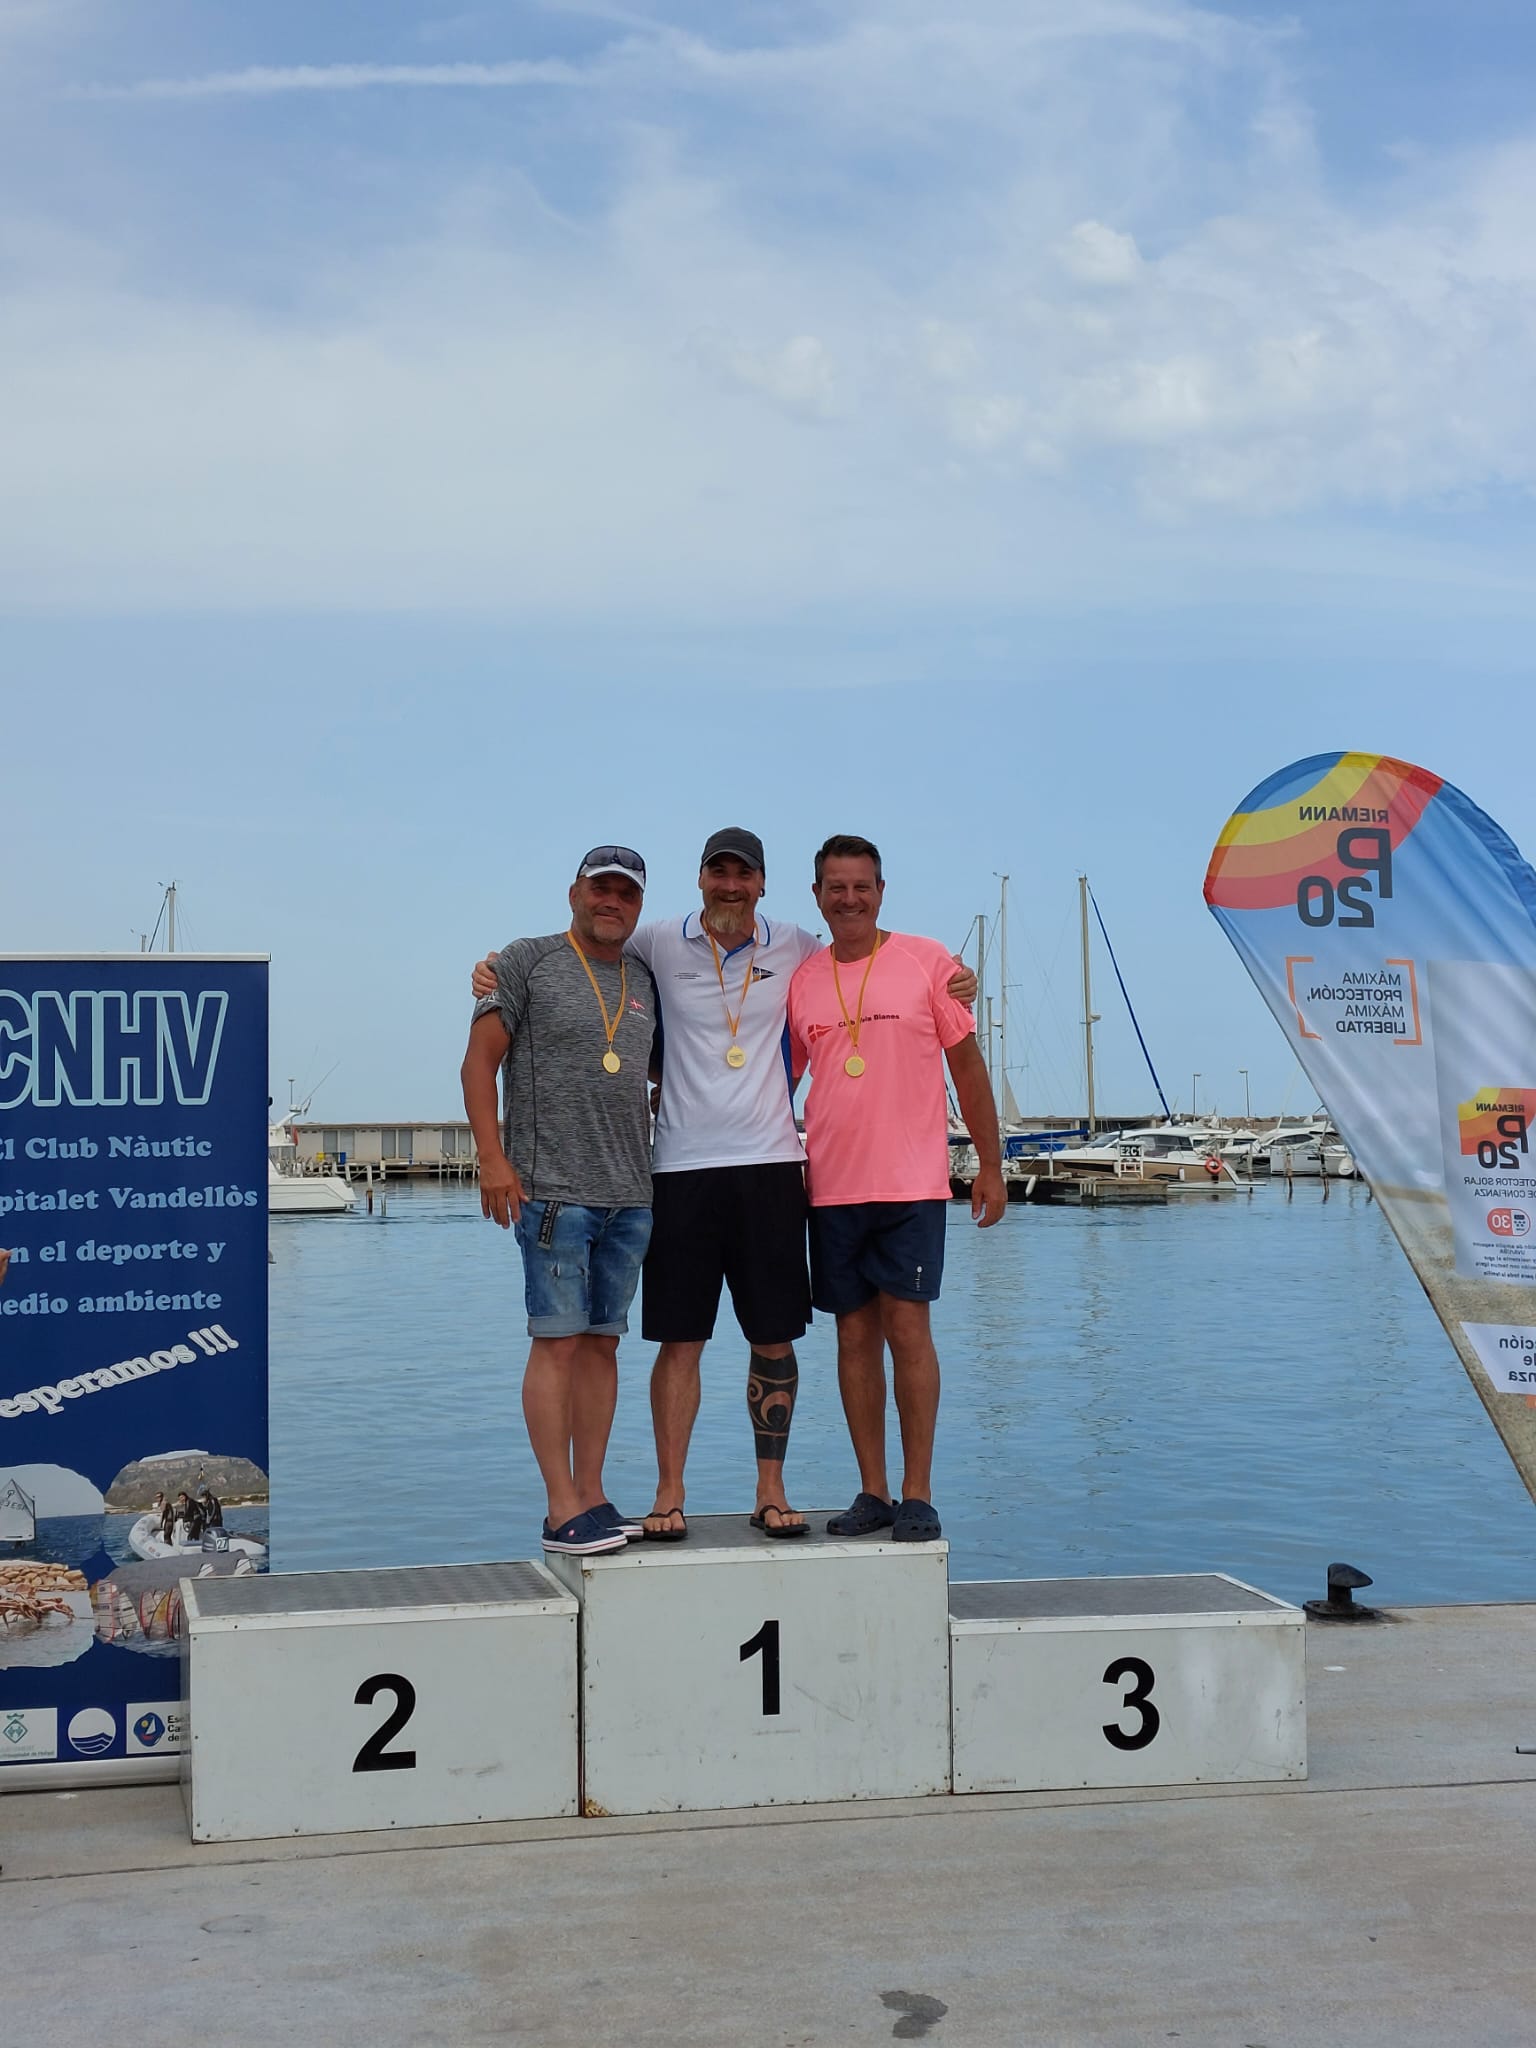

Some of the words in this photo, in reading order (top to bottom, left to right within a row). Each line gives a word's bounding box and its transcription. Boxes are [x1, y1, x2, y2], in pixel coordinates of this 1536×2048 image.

[0, 1138, 16, 1161] l
[25, 1137, 99, 1160] Club
[108, 1135, 213, 1158] Nàutic
[108, 1184, 258, 1210] Vandellòs
[39, 1240, 67, 1262] el
[76, 1239, 199, 1265] deporte
[207, 1241, 227, 1263] y
[78, 1289, 222, 1313] ambiente
[187, 1323, 240, 1356] !!!
[739, 1620, 780, 1716] 1
[1102, 1656, 1160, 1752] 3
[352, 1673, 416, 1773] 2
